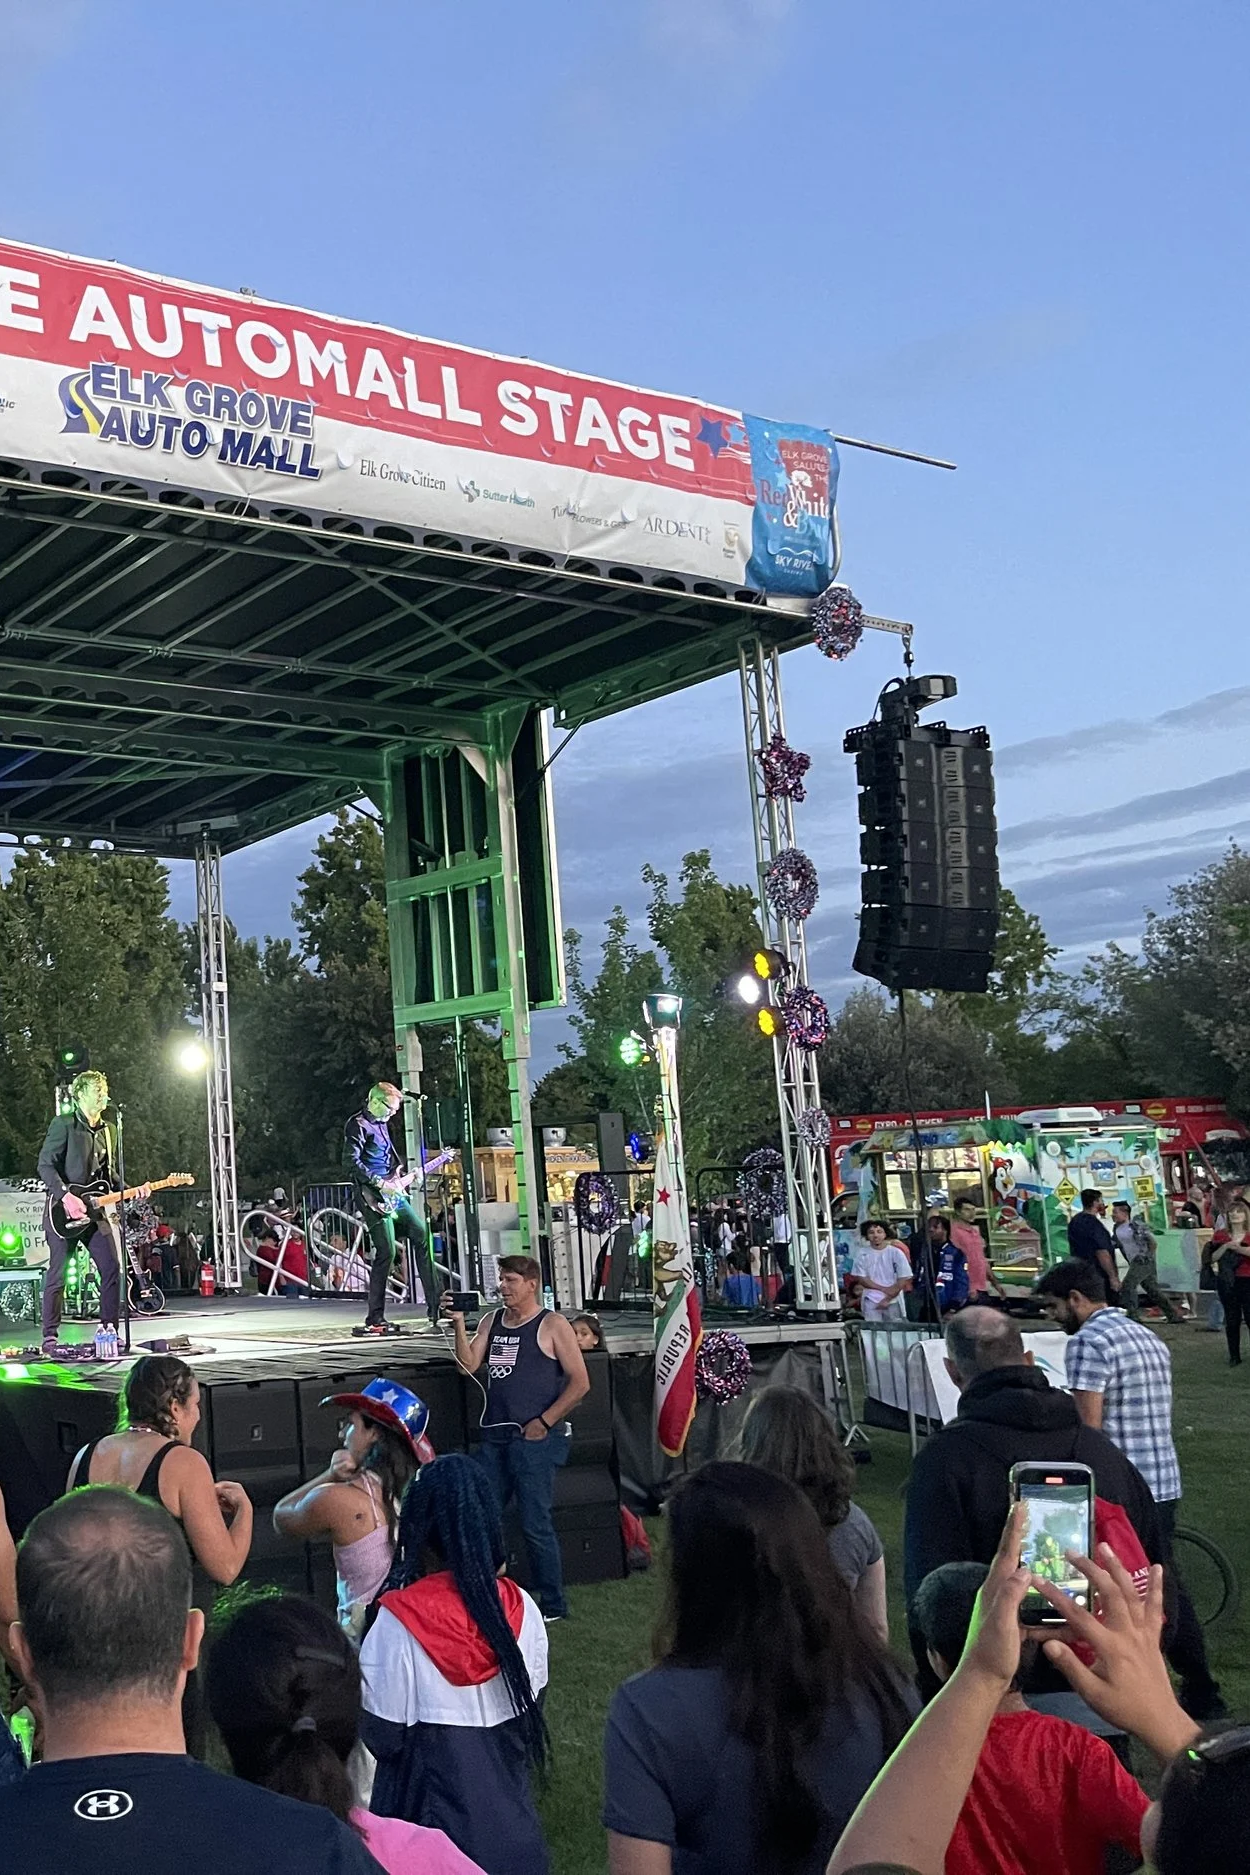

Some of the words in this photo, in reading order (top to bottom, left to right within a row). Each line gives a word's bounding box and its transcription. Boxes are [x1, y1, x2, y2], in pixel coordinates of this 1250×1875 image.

[68, 285, 483, 427] AUTOMALL
[498, 380, 696, 472] STAGE
[90, 363, 175, 411] ELK
[184, 380, 313, 437] GROVE
[99, 406, 210, 458] AUTO
[217, 428, 323, 479] MALL
[781, 450, 800, 460] ELK
[360, 459, 378, 478] Elk
[379, 462, 412, 484] Grove
[411, 469, 446, 491] Citizen
[483, 488, 509, 503] Sutter
[783, 500, 799, 528] &
[642, 516, 707, 542] ARDENT
[775, 554, 793, 567] SKY
[793, 558, 815, 571] RIVE
[904, 1117, 943, 1127] CICKEN
[15, 1206, 30, 1214] SKY
[19, 1221, 44, 1233] Rive
